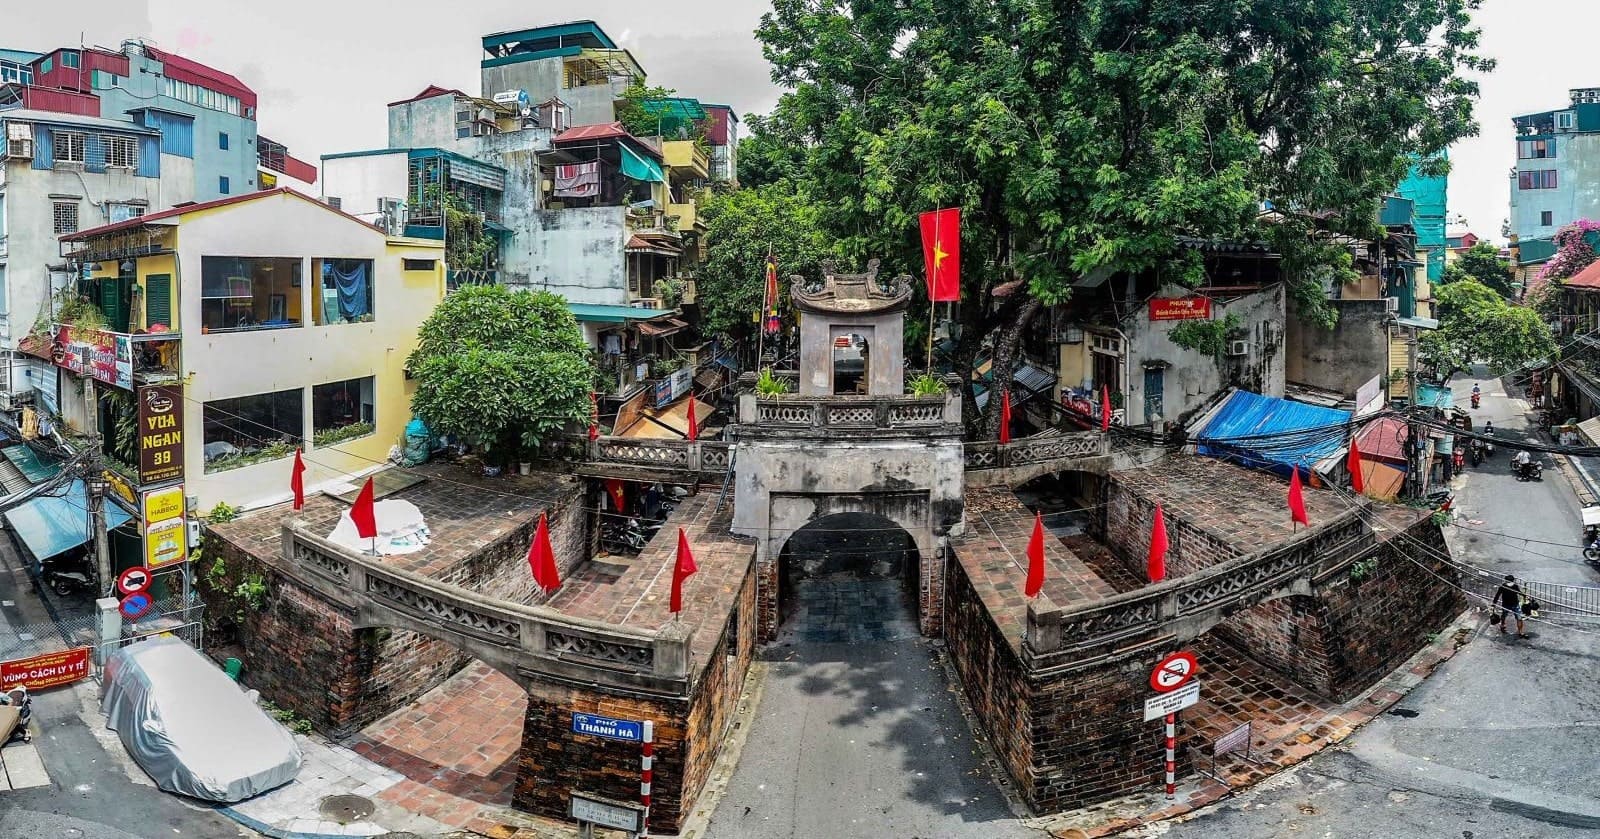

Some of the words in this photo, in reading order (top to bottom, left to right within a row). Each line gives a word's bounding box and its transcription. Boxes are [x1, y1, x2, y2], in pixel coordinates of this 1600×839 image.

[143, 431, 181, 449] NGAN
[151, 505, 178, 516] HABECO
[3, 671, 28, 683] VÙNG
[30, 667, 56, 678] CÁCH
[58, 666, 66, 674] LY
[69, 664, 74, 672] Y
[76, 658, 86, 670] TẾ
[580, 723, 615, 735] THANH
[618, 728, 634, 738] HÀ
